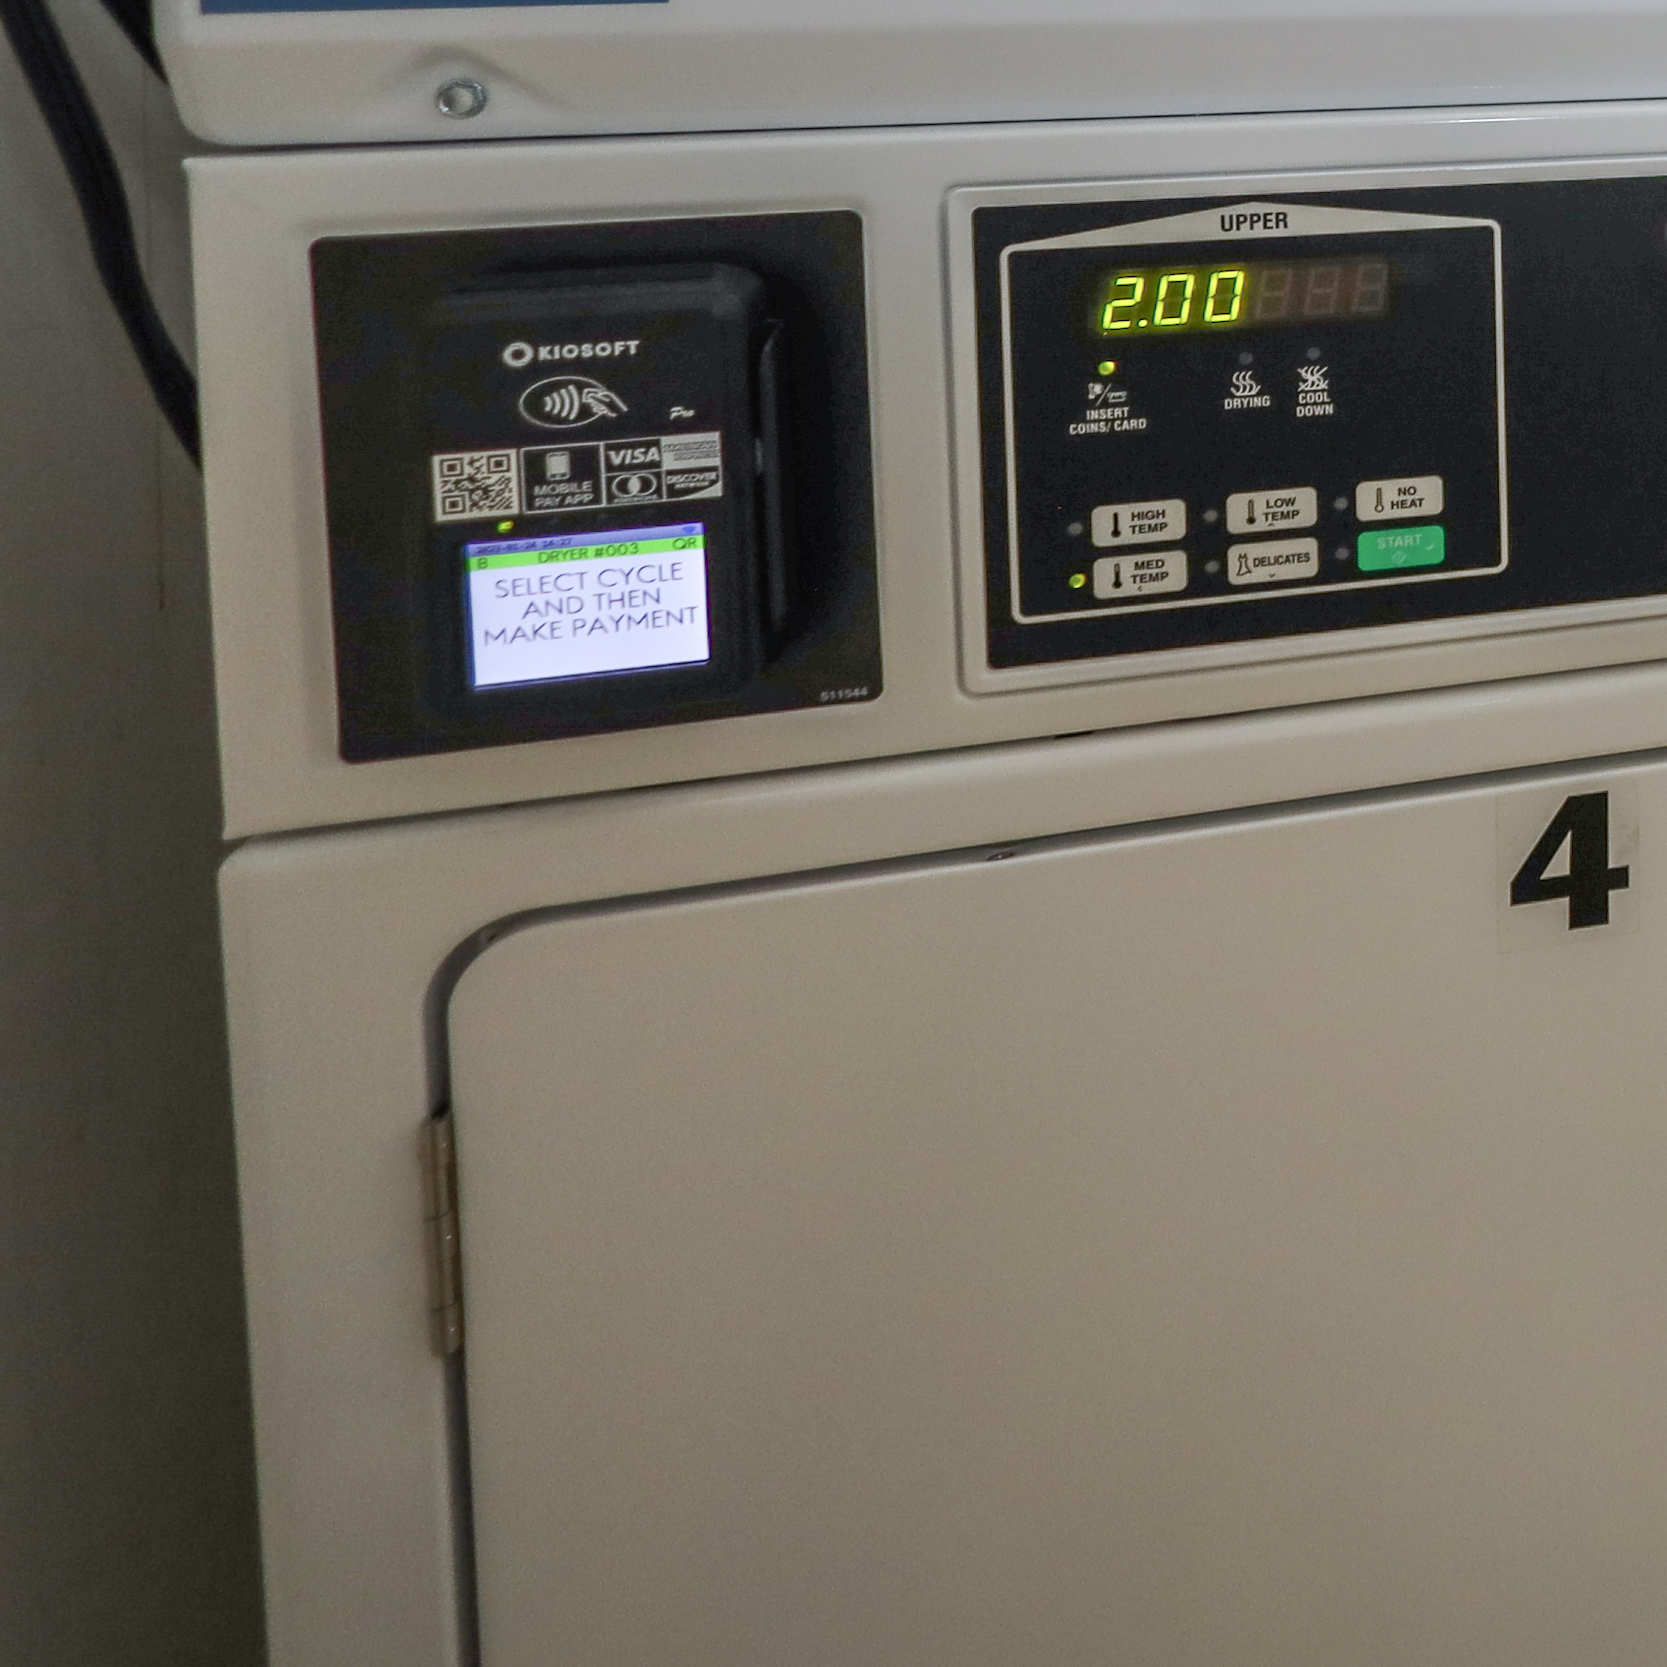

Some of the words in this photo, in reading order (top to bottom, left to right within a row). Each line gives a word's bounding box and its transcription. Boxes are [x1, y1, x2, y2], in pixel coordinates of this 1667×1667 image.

[1220, 212, 1288, 232] UPPER
[1102, 269, 1246, 330] 2.00
[538, 340, 640, 361] KIOSOFT
[1224, 395, 1270, 410] DRYING
[1299, 392, 1331, 404] COOL
[1086, 407, 1129, 421] INSERT
[1296, 404, 1334, 417] DOWN
[1114, 418, 1147, 431] CARD
[607, 446, 660, 467] VISA
[533, 481, 593, 496] MOBILE
[1398, 485, 1417, 497] NO
[534, 496, 560, 508] PAY
[566, 494, 593, 505] APP
[1265, 496, 1296, 509] LOW
[1391, 497, 1425, 510] HEAT
[1130, 508, 1166, 521] HIGH
[1262, 508, 1300, 522] TEMP
[1129, 521, 1168, 535] TEMP
[1377, 534, 1423, 549] START
[537, 549, 588, 564] DRYER
[594, 543, 639, 558] #003
[672, 537, 697, 550] QR
[1134, 558, 1165, 572] MED
[1253, 553, 1310, 568] DELICATES
[494, 571, 589, 599] SELECT
[597, 562, 684, 588] CYCLE
[1130, 571, 1169, 584] TEMP
[522, 596, 584, 620] AND
[592, 588, 661, 612] THEN
[483, 620, 564, 647] MAKE
[571, 606, 699, 638] PAYMENT
[1509, 790, 1629, 930] 4
